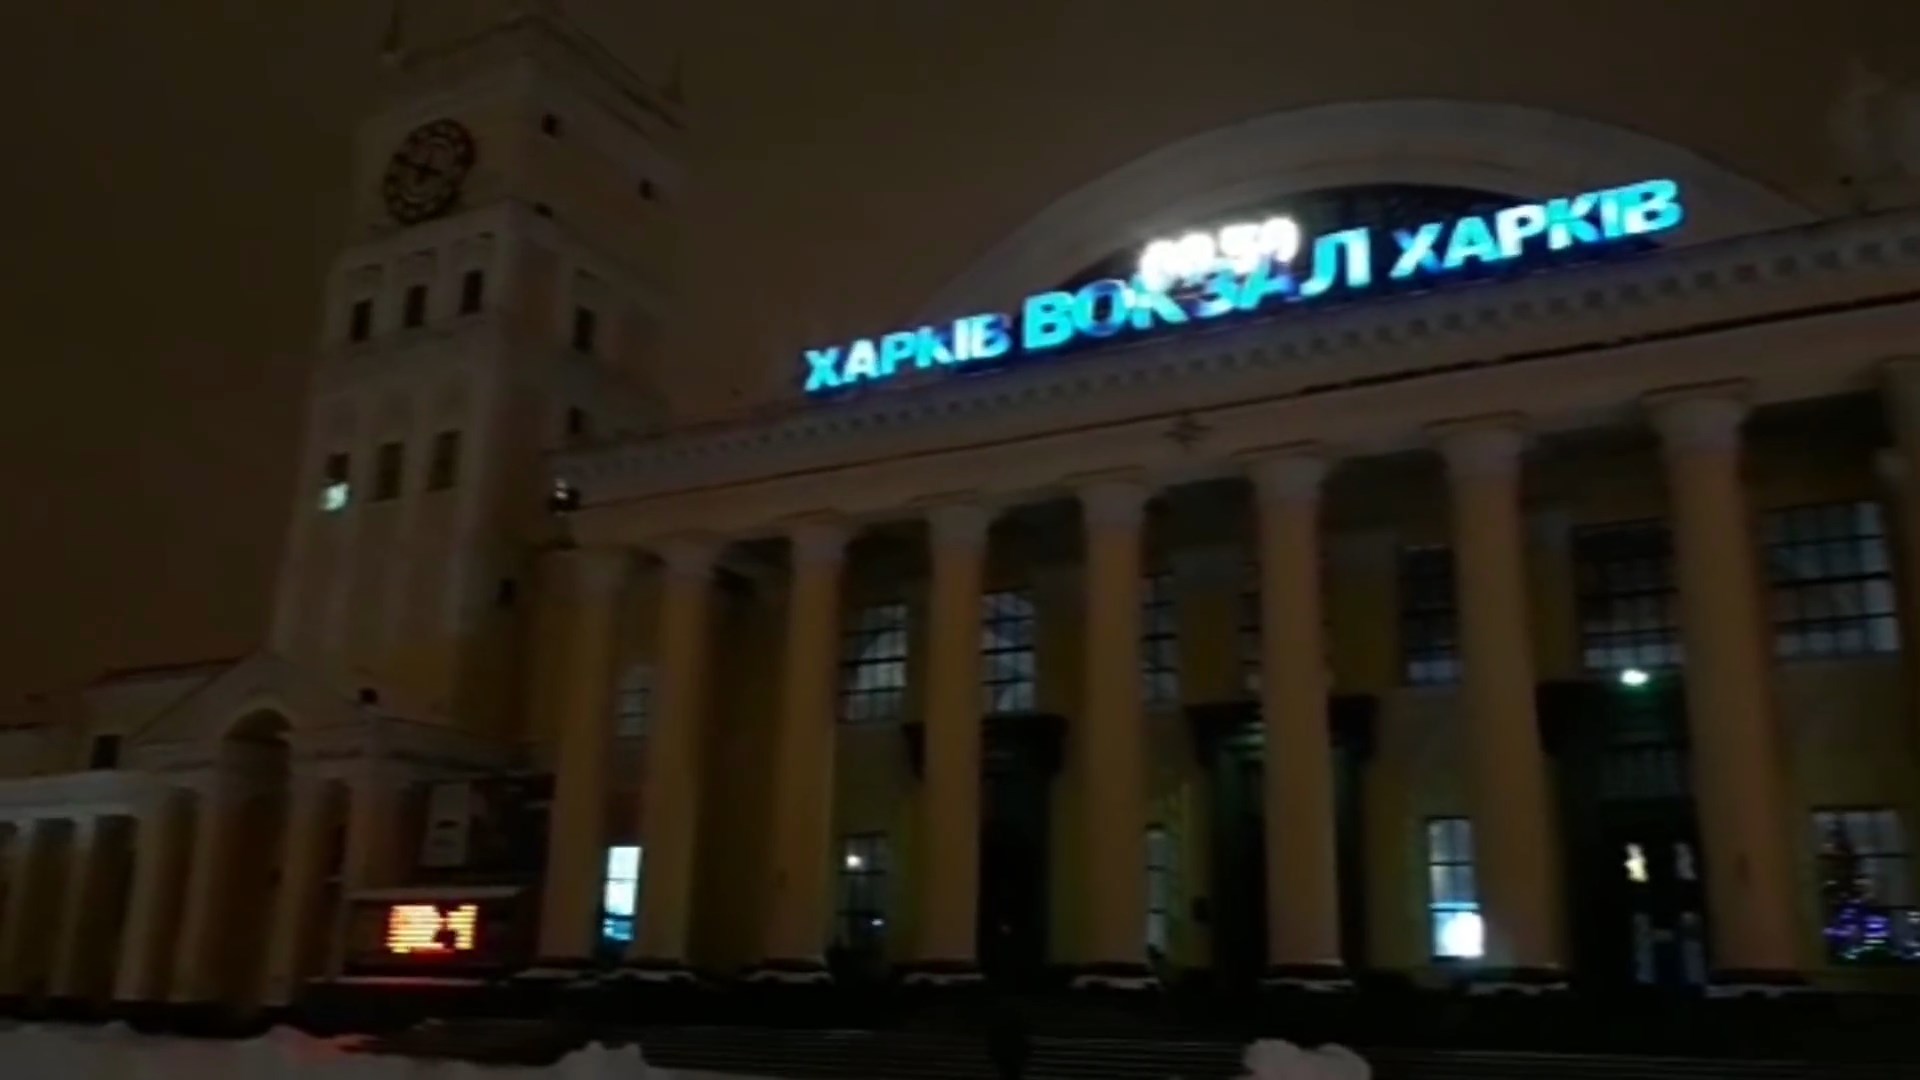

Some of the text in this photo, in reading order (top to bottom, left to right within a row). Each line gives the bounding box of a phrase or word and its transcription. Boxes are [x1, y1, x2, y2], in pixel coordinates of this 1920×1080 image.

[804, 314, 1011, 392] ХАРКІВ
[1022, 228, 1371, 350] ВОКЗАЛ
[1388, 179, 1682, 278] ХАРКІВ
